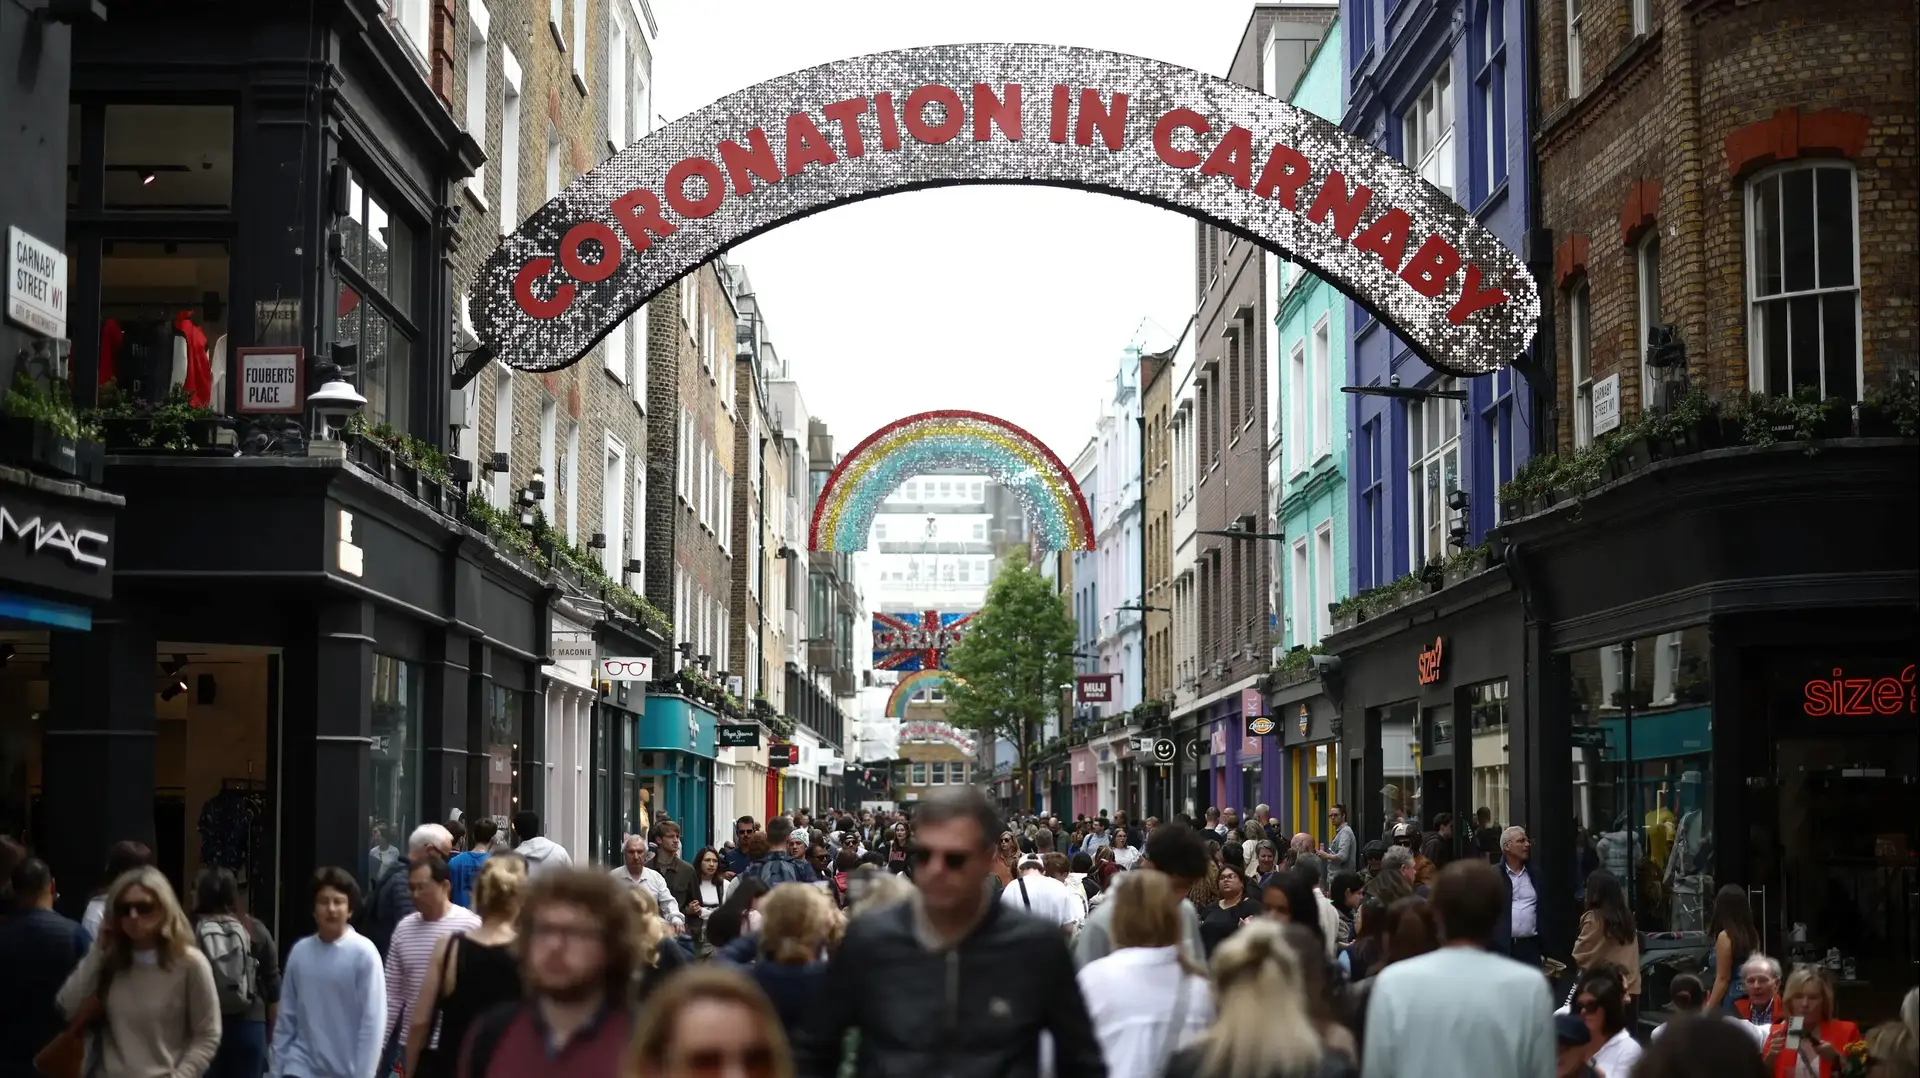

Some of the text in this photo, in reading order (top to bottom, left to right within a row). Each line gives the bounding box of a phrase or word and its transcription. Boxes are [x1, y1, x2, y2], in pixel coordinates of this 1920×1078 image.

[514, 83, 1508, 326] CORONATION IN CARNABY
[16, 241, 56, 281] CARNABY
[17, 268, 63, 312] STREET W1
[249, 387, 280, 403] PLACE
[559, 648, 592, 656] MACONIE
[1418, 636, 1442, 685] size?
[1083, 682, 1107, 693] MUJI
